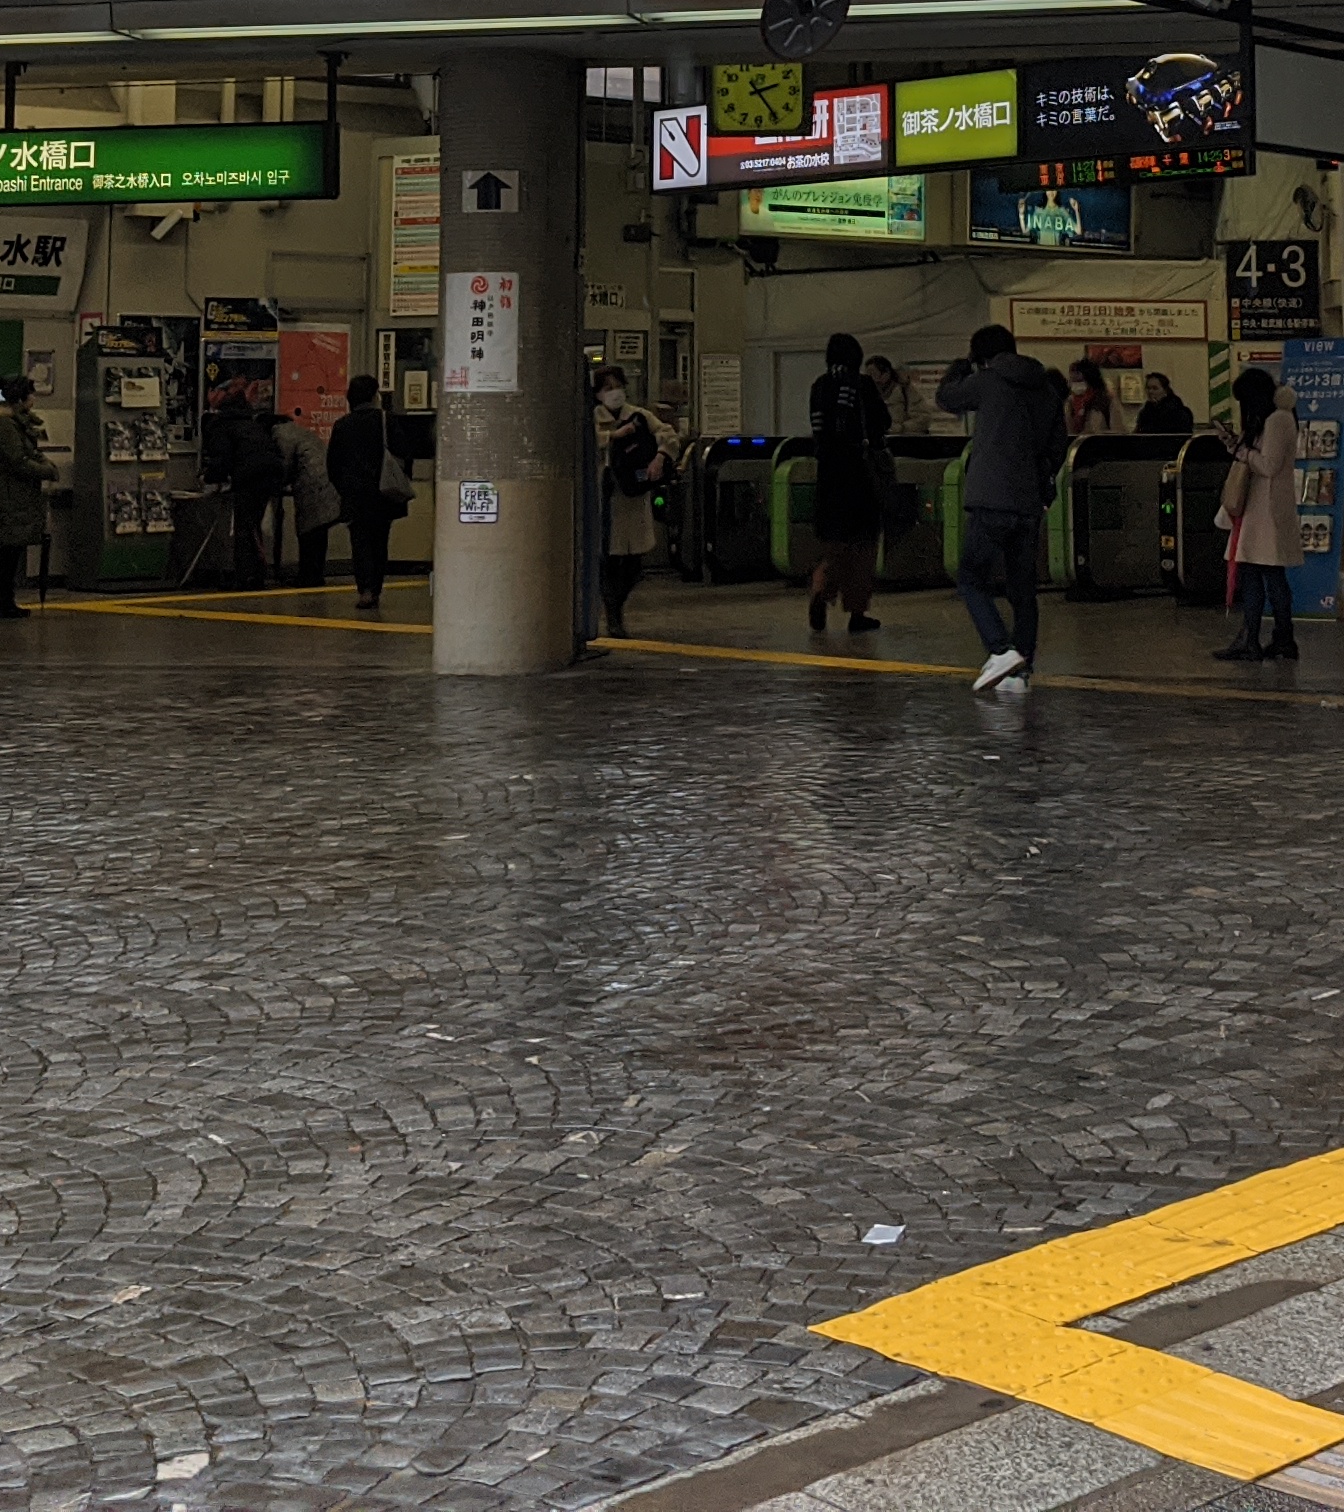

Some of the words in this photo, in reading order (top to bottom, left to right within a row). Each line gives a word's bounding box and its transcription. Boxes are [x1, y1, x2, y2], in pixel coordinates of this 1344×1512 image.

[1036, 86, 1114, 107] キミの技術は、
[902, 101, 1010, 136] 御茶ノ水橋口
[1036, 105, 1115, 127] キミの言葉だ。
[30, 174, 83, 192] Entrance
[181, 170, 262, 187] 오차노미즈바시
[266, 169, 290, 186] 입구
[1027, 214, 1075, 231] INABA
[470, 299, 486, 361] 神田明神
[465, 491, 489, 500] FREE
[464, 501, 489, 511] Wi-Fi
